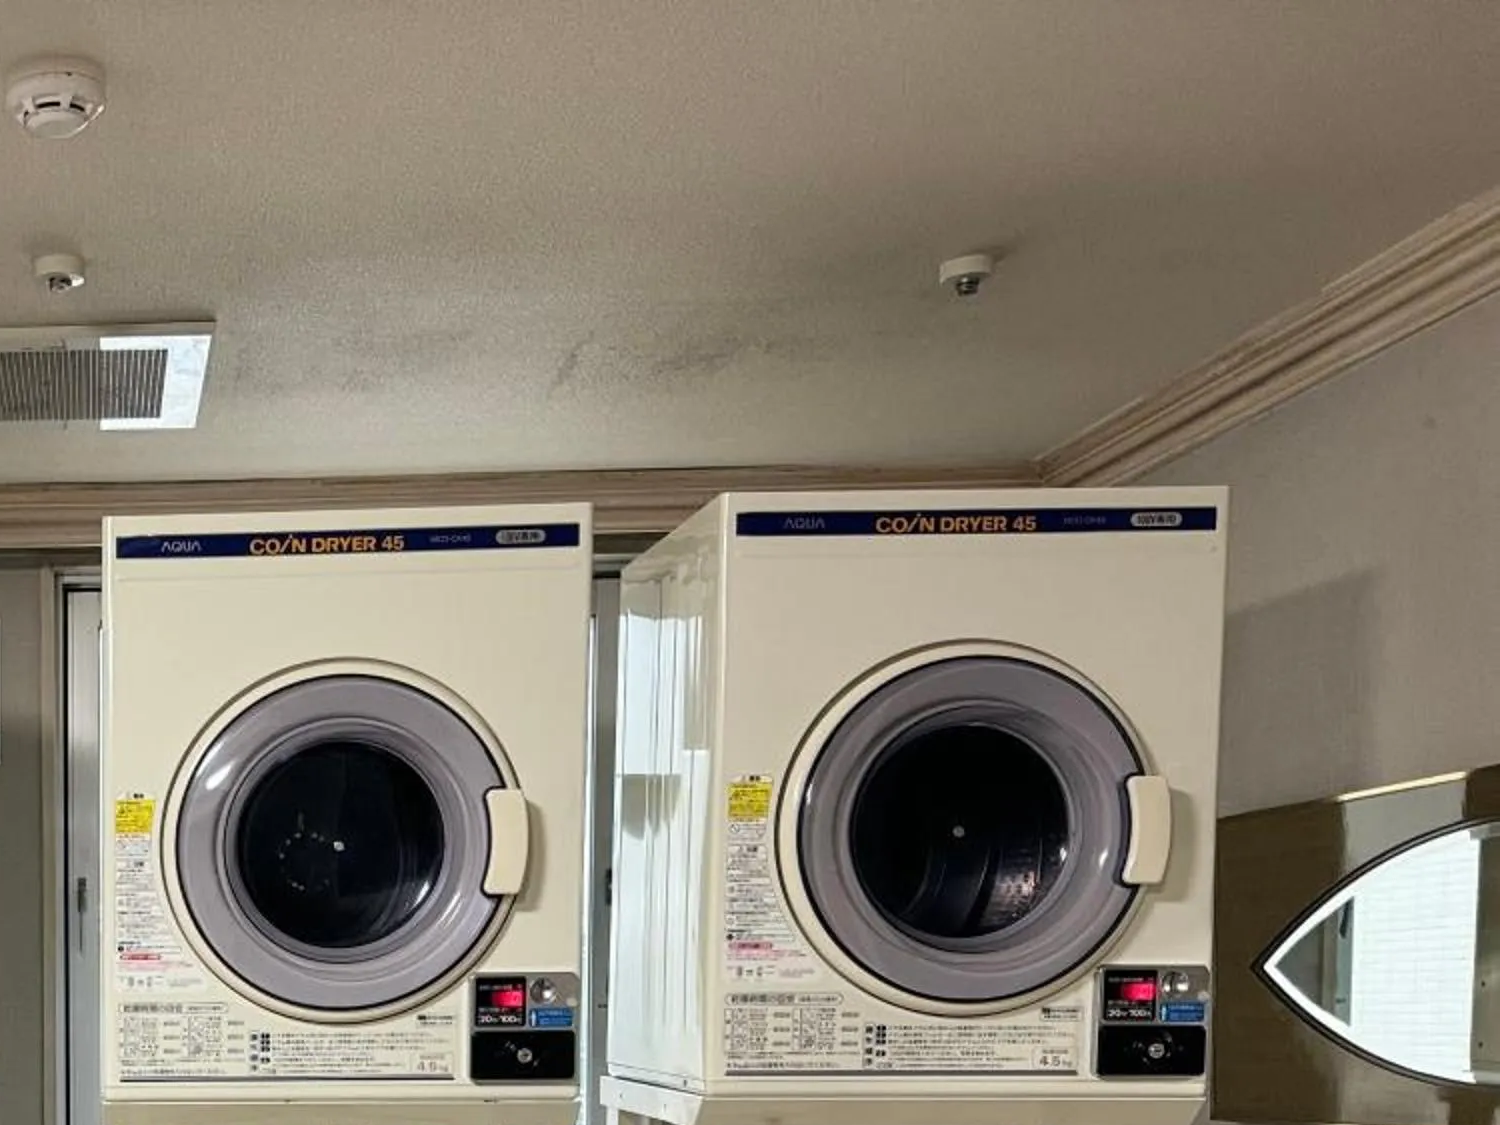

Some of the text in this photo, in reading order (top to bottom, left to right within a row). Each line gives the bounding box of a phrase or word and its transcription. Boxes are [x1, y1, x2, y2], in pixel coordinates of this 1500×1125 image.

[784, 516, 825, 530] AQUA
[940, 515, 1008, 532] DRYER
[1012, 515, 1037, 531] 45
[161, 540, 201, 554] AQUA
[311, 535, 377, 553] DRYER
[381, 535, 405, 551] 45
